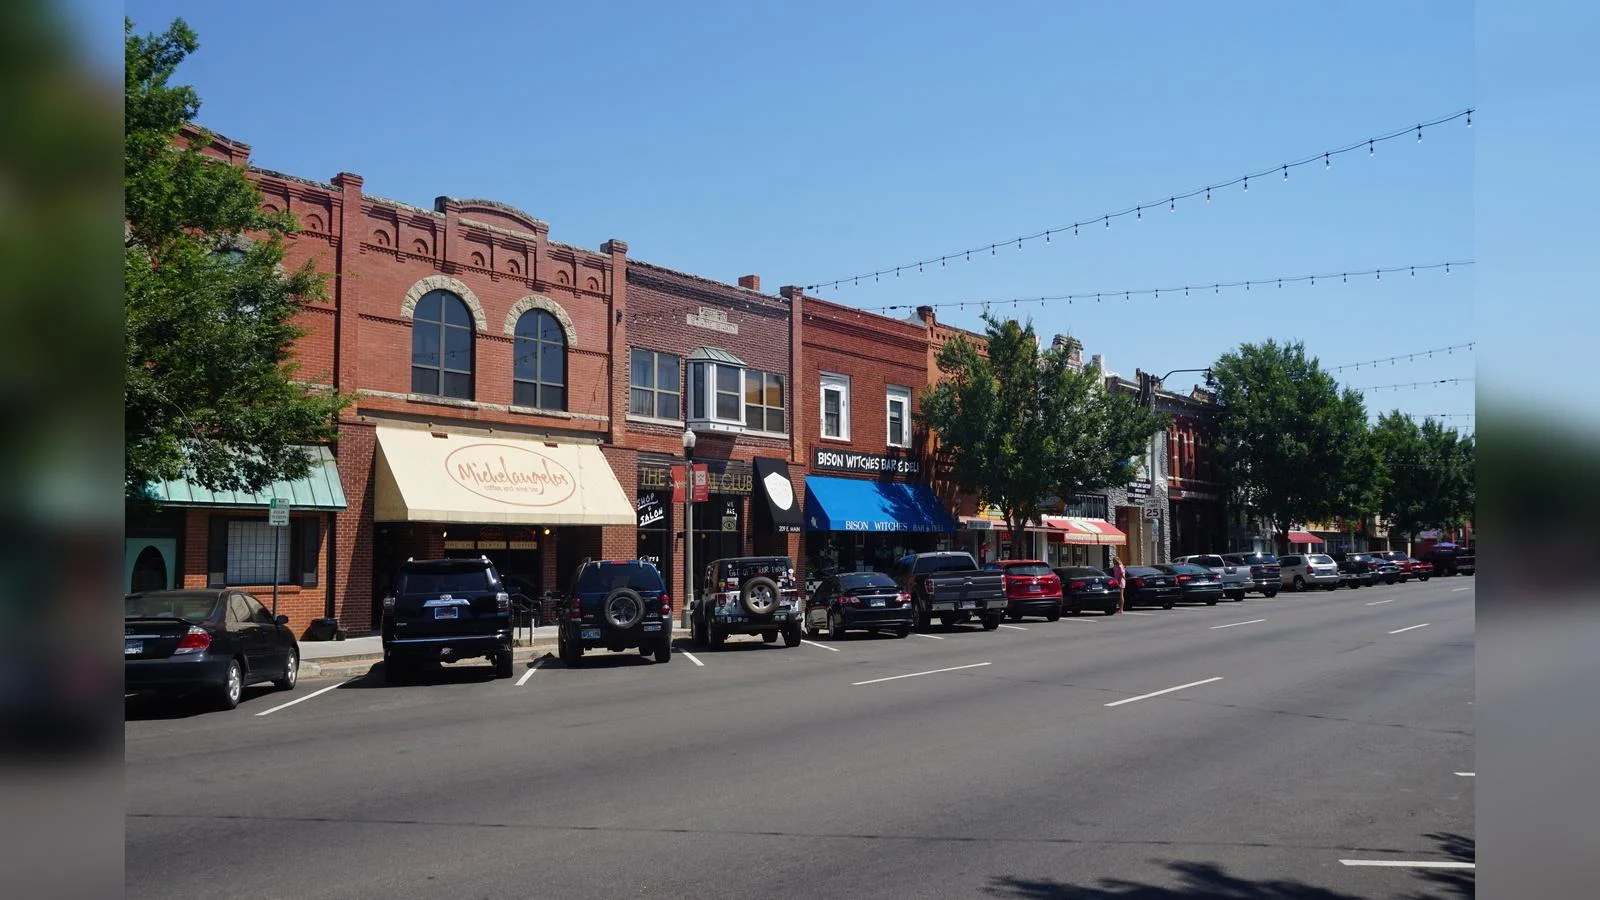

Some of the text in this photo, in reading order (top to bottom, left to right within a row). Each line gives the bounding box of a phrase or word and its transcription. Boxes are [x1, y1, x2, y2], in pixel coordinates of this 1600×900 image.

[818, 452, 920, 473] BISON WITCHES BAR & DELI
[641, 467, 666, 487] THE
[720, 473, 753, 492] CLUB
[637, 492, 655, 507] SHOP
[640, 507, 663, 524] SALON
[1146, 508, 1159, 517] 25
[845, 520, 869, 530] BISON
[874, 520, 908, 531] WITCHES
[912, 523, 926, 532] BAR
